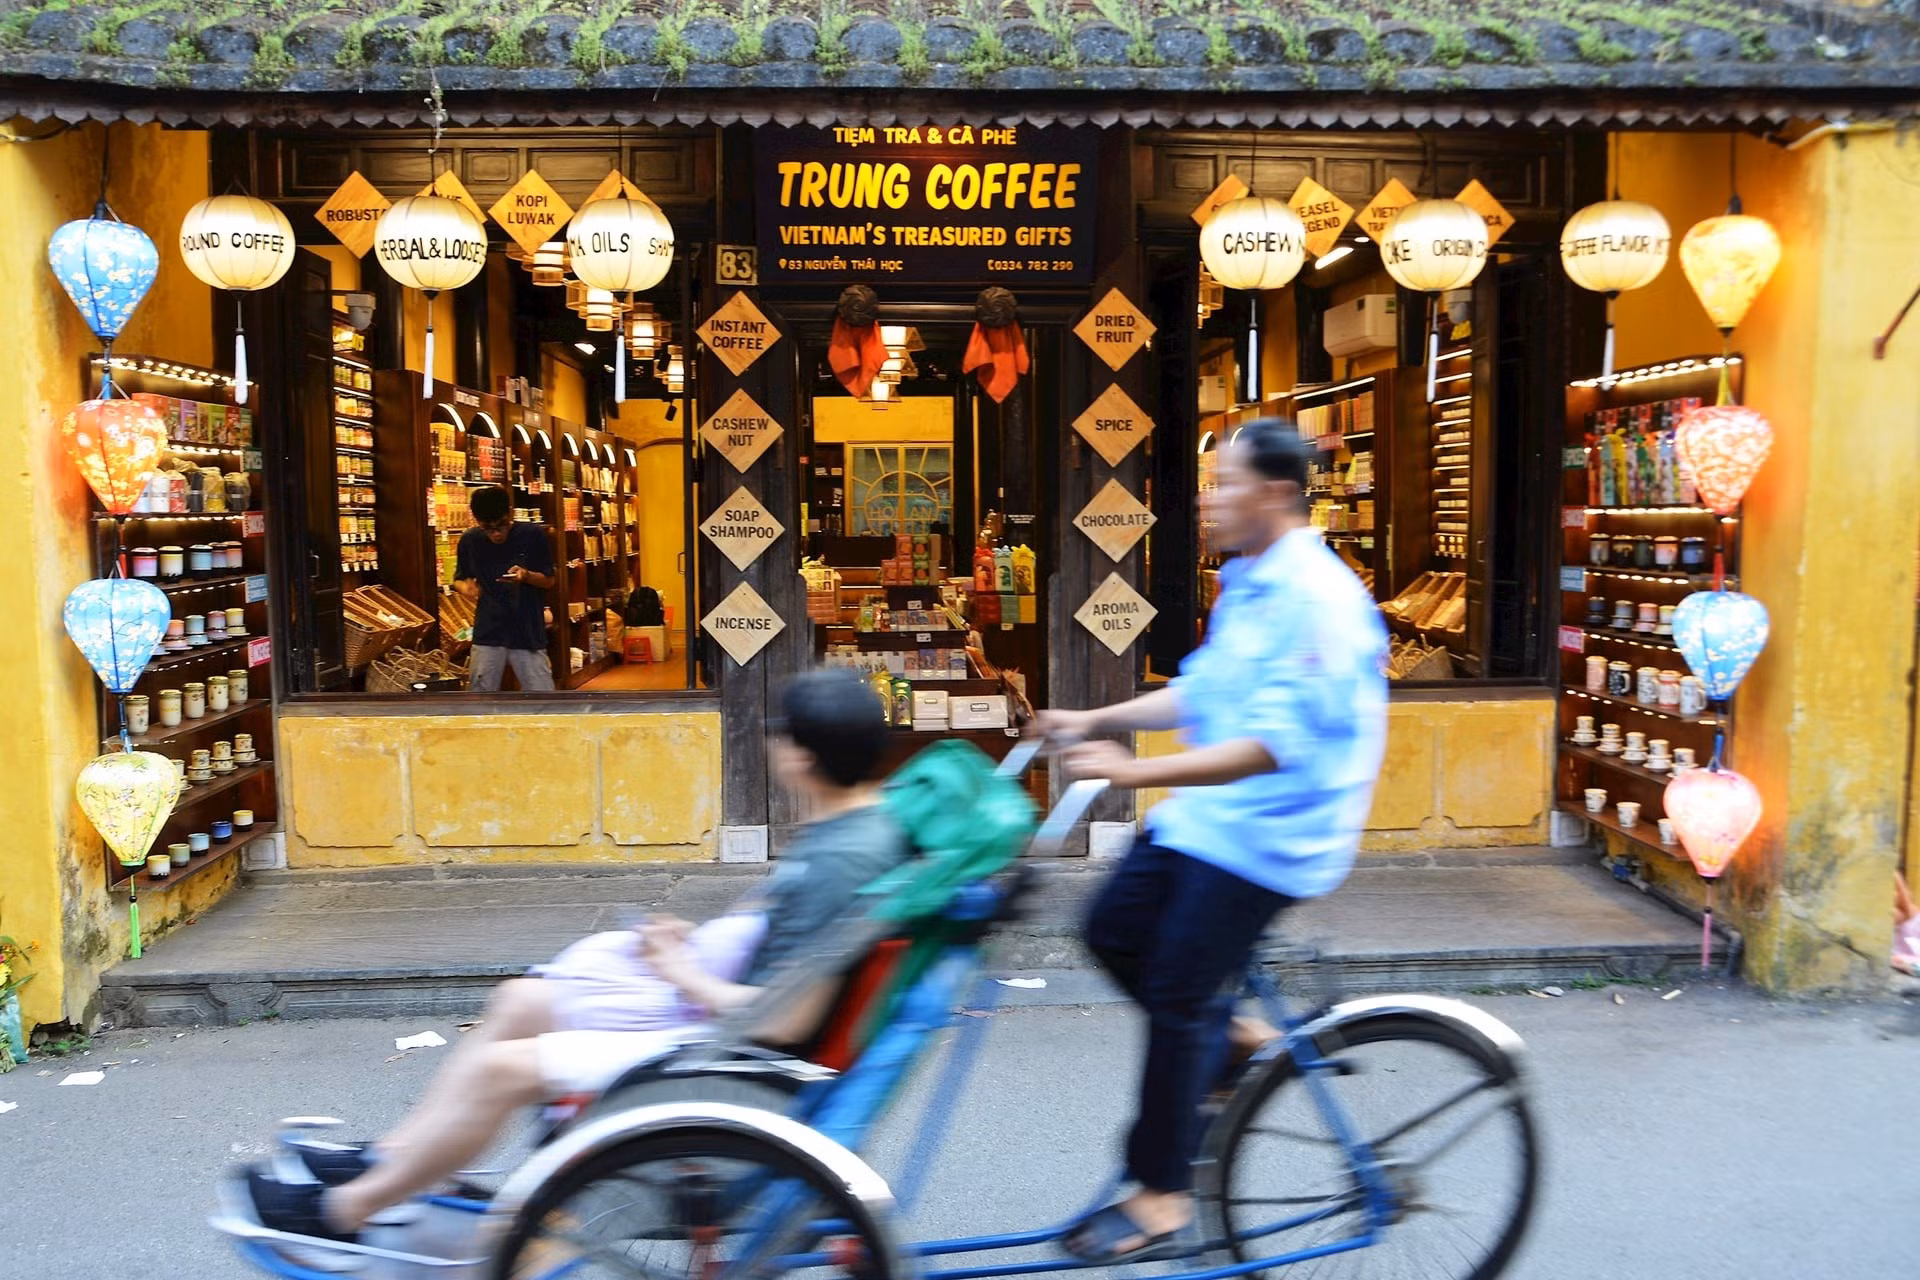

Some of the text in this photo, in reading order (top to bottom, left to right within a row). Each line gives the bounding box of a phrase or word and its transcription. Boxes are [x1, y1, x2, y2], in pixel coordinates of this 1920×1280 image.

[927, 127, 942, 144] &
[778, 161, 1081, 210] TRUNG COFFEE
[516, 195, 548, 208] KOPI
[1297, 201, 1340, 218] EASEL
[508, 212, 555, 225] LUWAK
[779, 222, 1072, 246] VIETNAM'S TREASURED GIFTS
[592, 231, 630, 253] OILS
[1223, 231, 1292, 254] CASHEW
[721, 251, 752, 279] 83
[788, 259, 802, 270] 83
[880, 260, 903, 272] HỌC
[994, 261, 1023, 271] 0334
[1028, 261, 1048, 271] 782
[711, 320, 767, 334] INSTANT
[1095, 315, 1135, 327] DRIED
[712, 336, 763, 350] COFFEE
[1096, 331, 1134, 343] FRUIT
[712, 418, 769, 431] CASHEW
[1095, 419, 1133, 431] SPICE
[728, 434, 754, 447] NUT
[725, 510, 759, 522] SOAP
[1081, 513, 1149, 527] CHOCOLATE
[709, 525, 774, 539] SHAMPOO
[1093, 602, 1139, 616] AROMA
[715, 617, 771, 631] INCENSE
[1102, 618, 1132, 631] OILS
